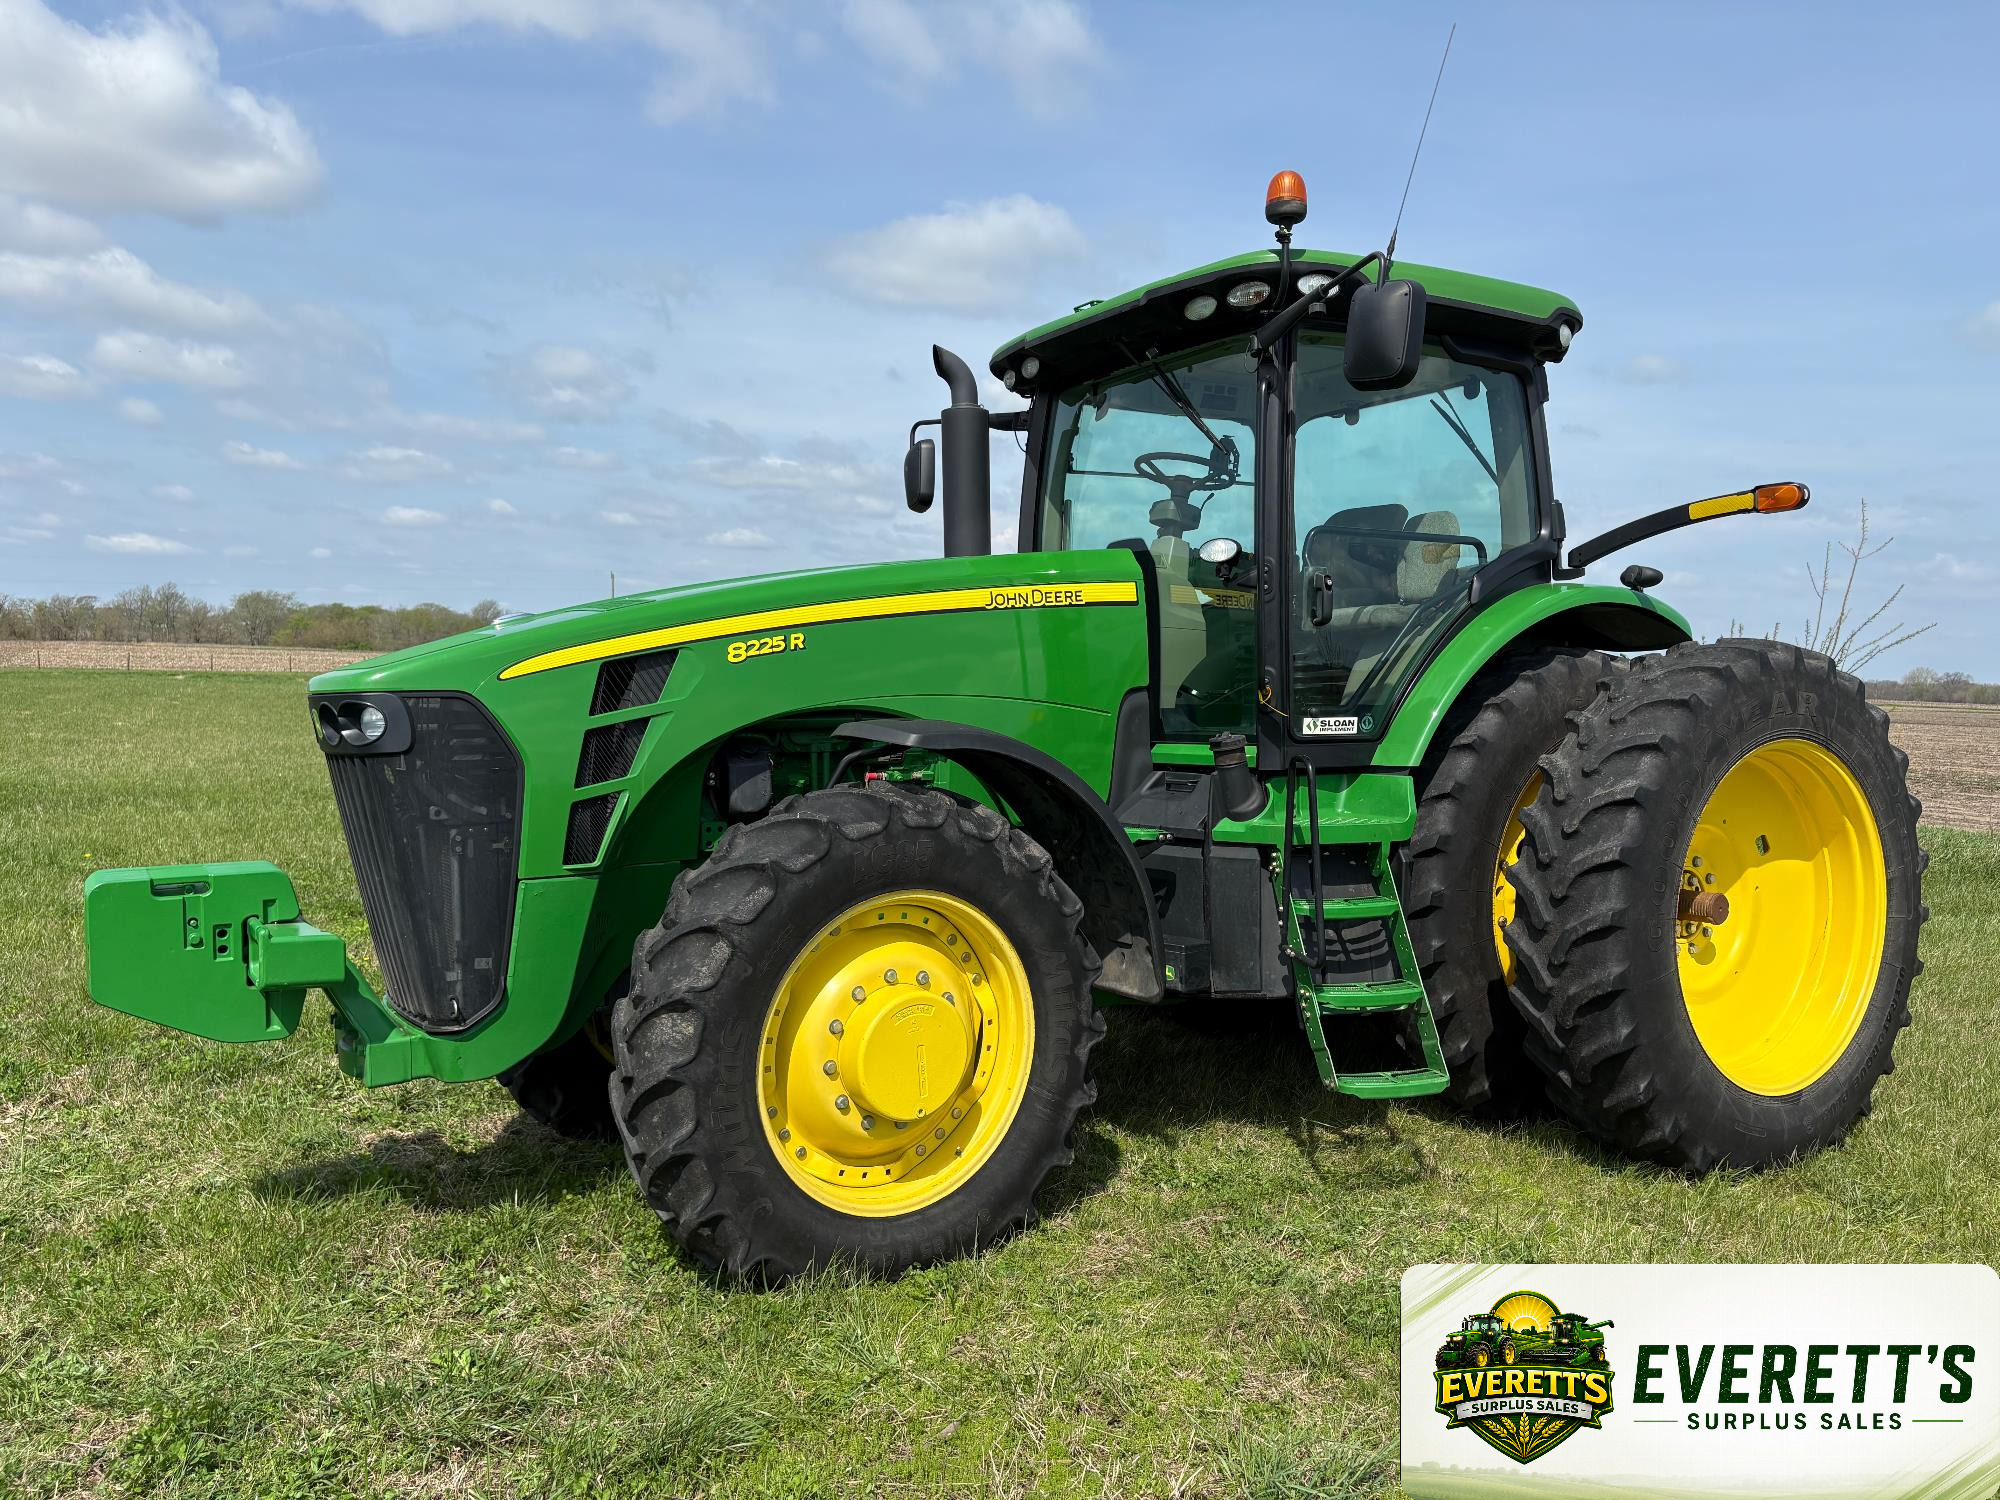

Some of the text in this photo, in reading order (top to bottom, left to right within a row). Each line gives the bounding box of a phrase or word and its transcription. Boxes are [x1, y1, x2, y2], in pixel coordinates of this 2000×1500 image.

[985, 589, 1085, 609] JOHN DEERE
[727, 632, 806, 664] 8225 R
[1320, 719, 1355, 727] SLOAN
